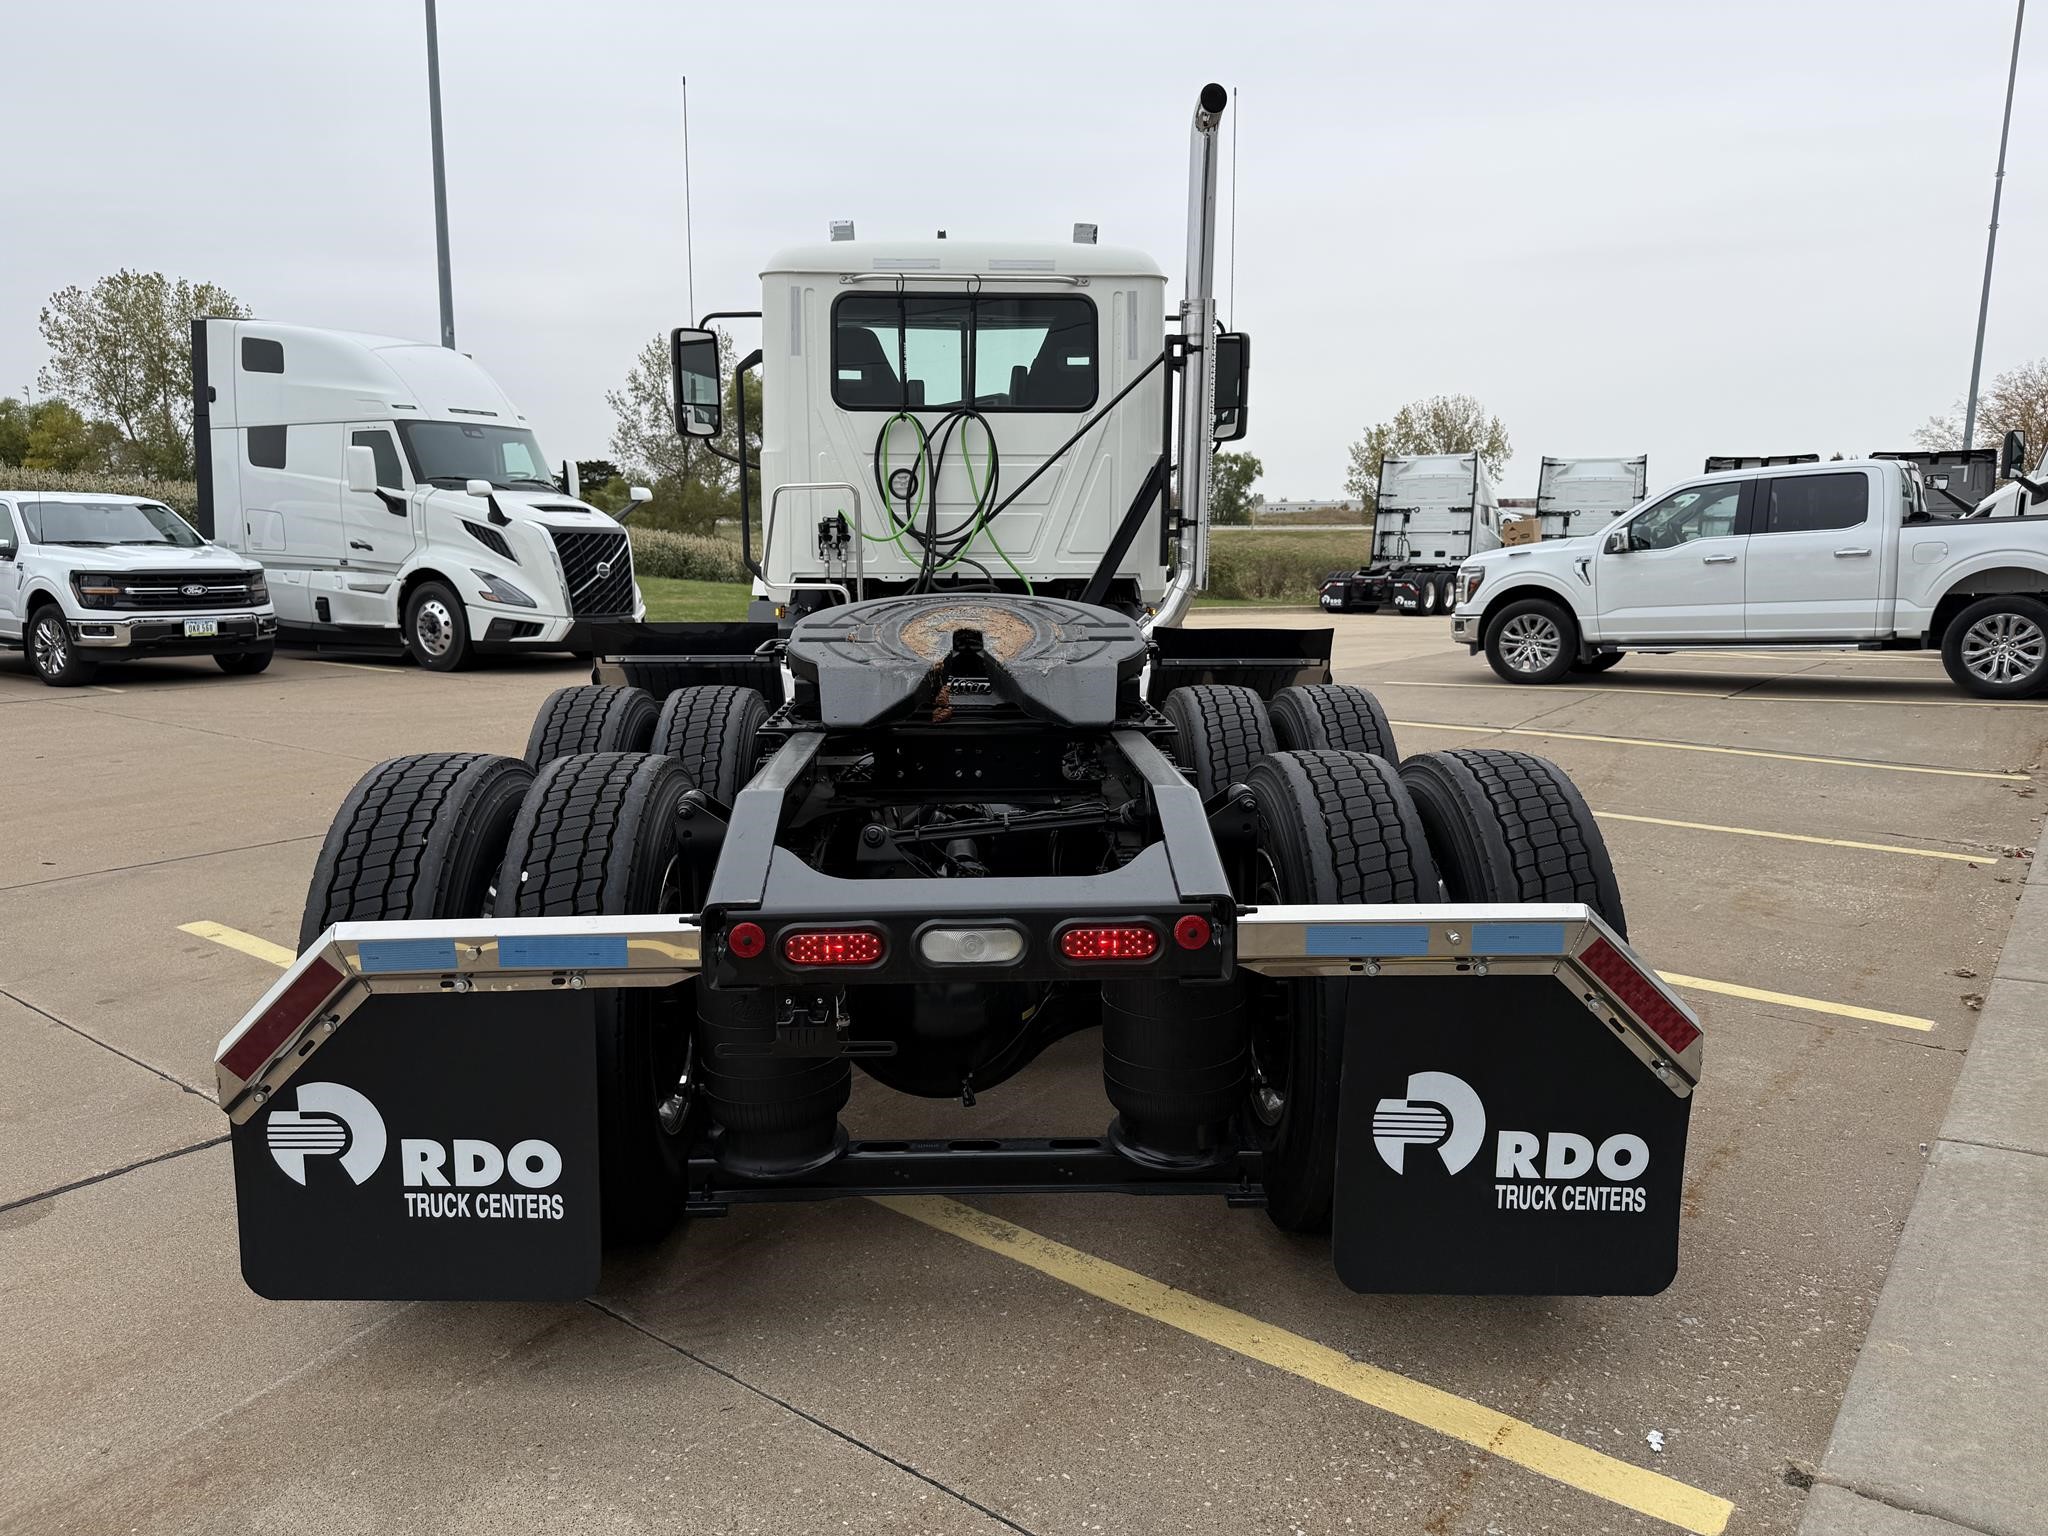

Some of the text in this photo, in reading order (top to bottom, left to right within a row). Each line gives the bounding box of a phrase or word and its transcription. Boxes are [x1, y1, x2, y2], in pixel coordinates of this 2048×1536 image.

[400, 1138, 563, 1189] RDO
[1495, 1130, 1650, 1182] RDO
[403, 1192, 564, 1220] TRUCK CENTERS
[1494, 1184, 1647, 1213] TRUCK CENTERS
